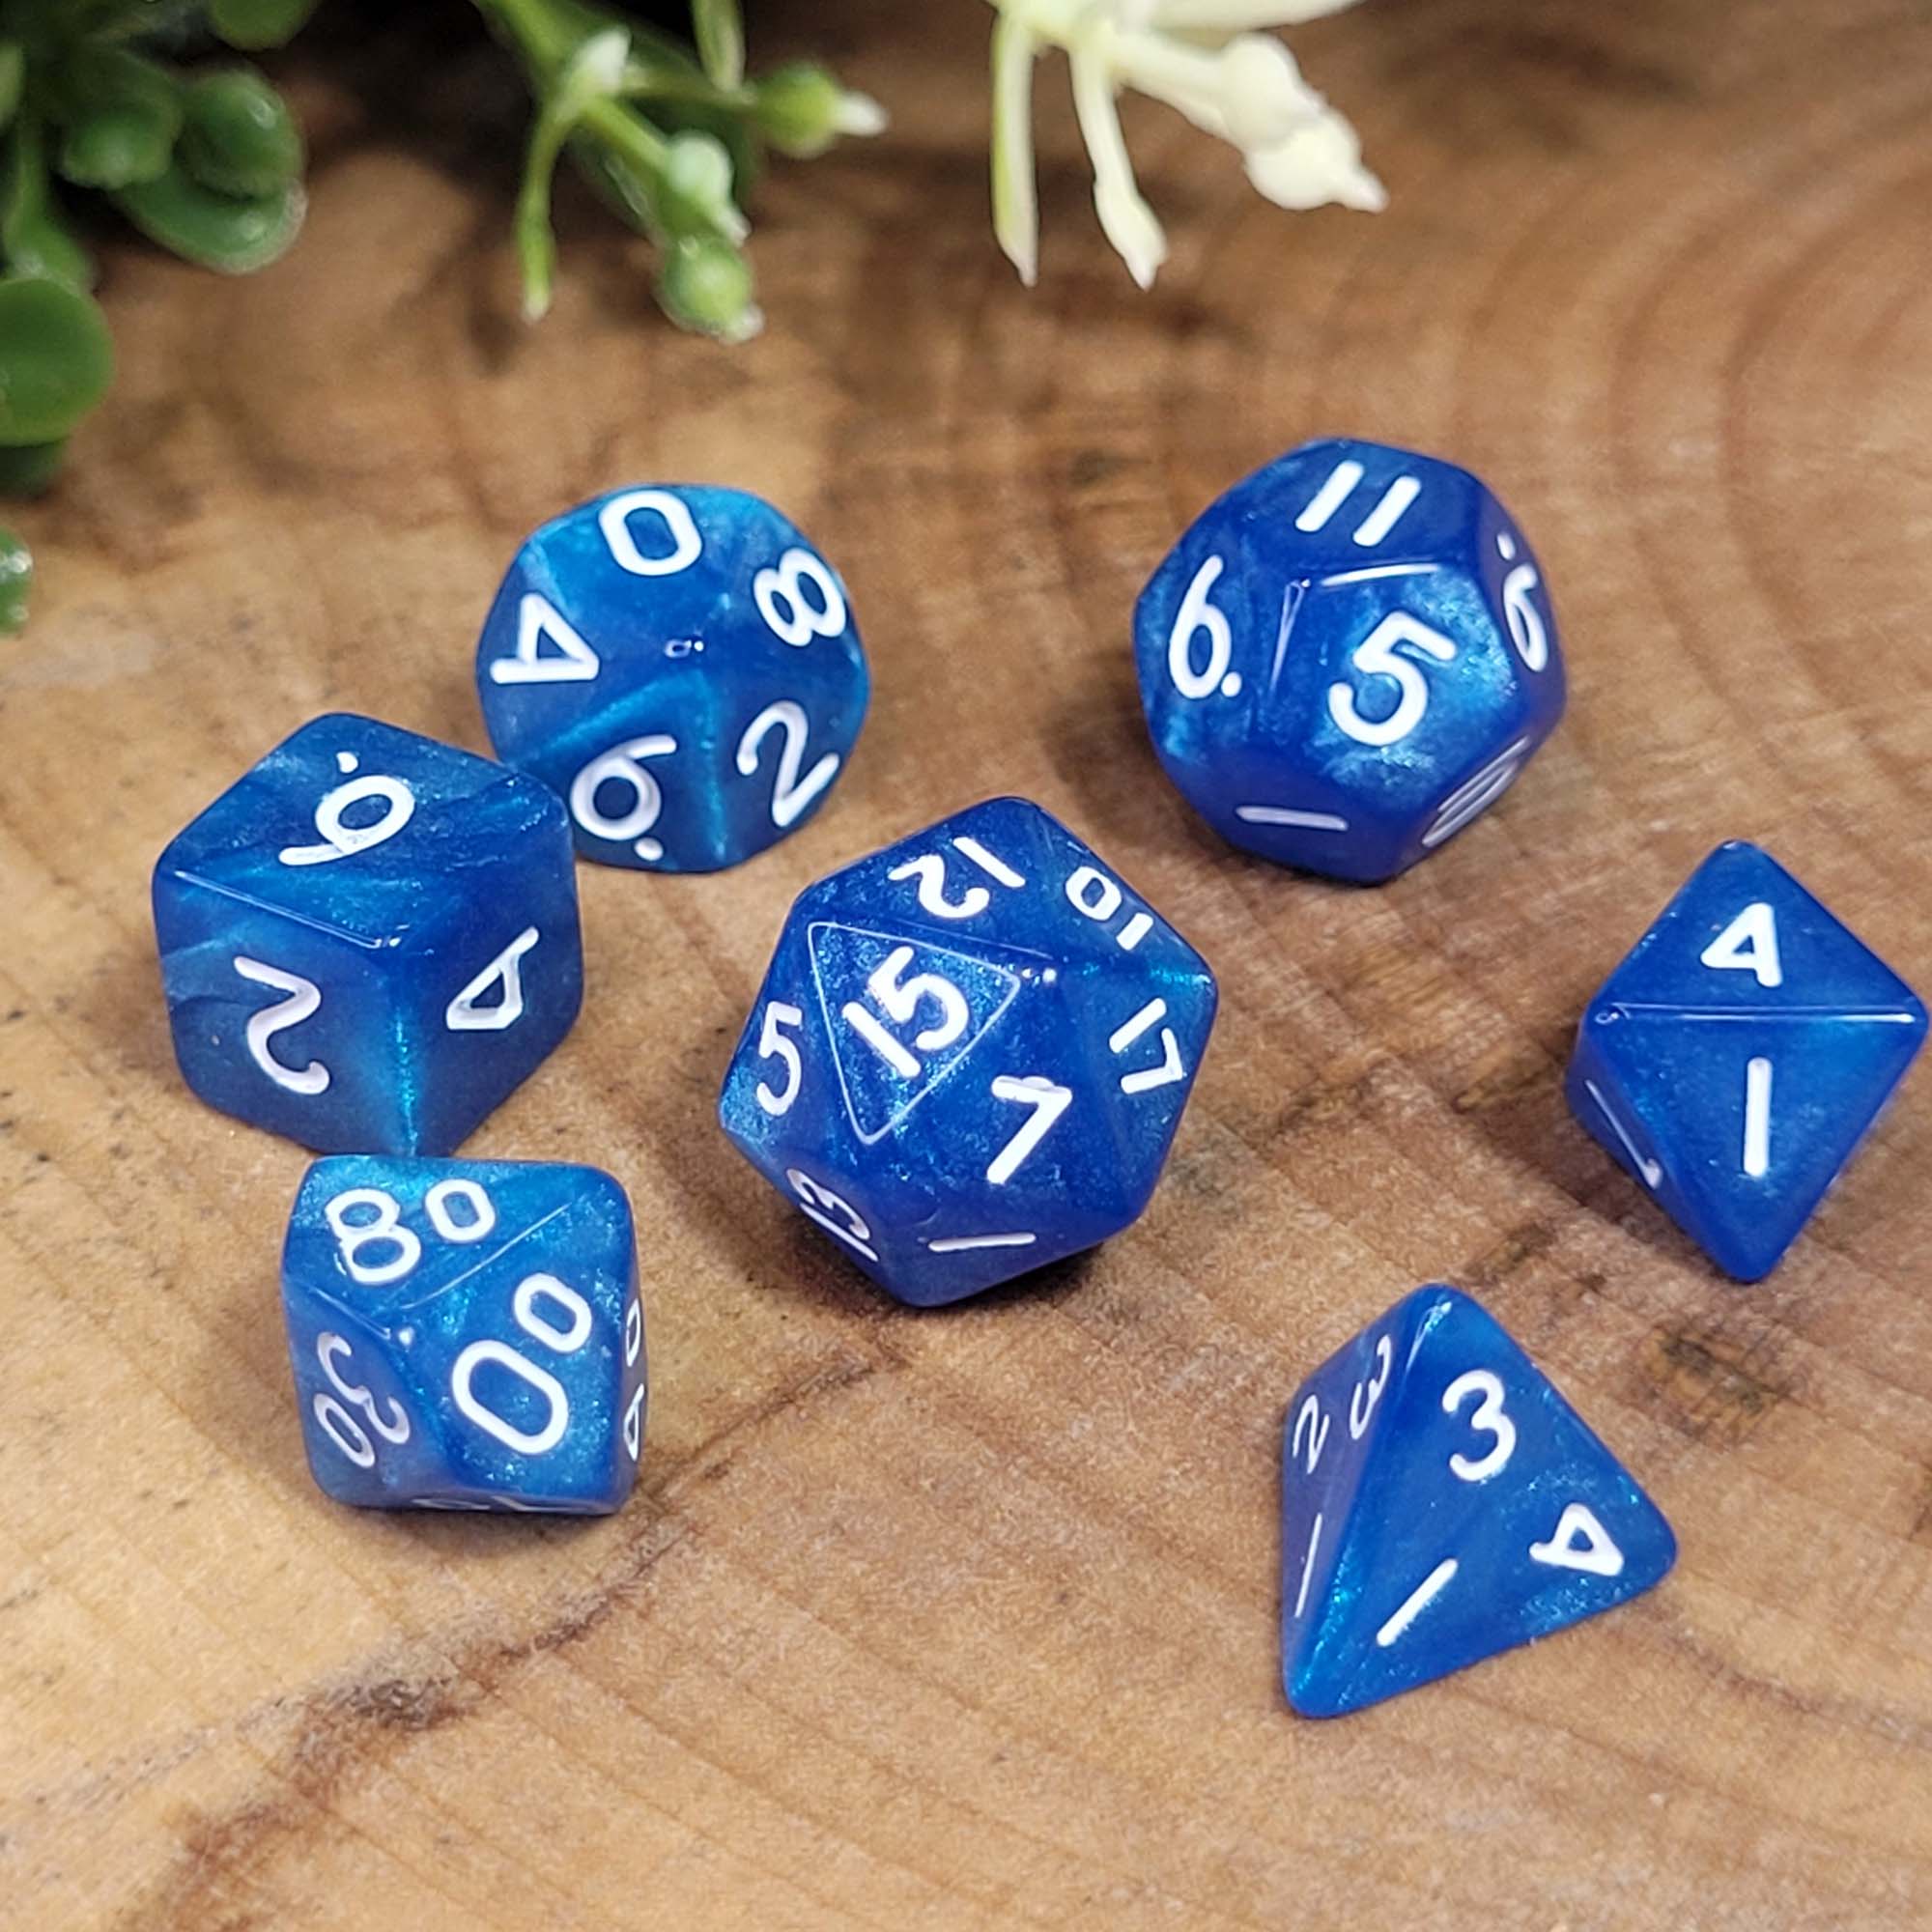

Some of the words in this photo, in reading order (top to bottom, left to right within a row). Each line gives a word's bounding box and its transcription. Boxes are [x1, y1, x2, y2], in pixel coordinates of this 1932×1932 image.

[598, 489, 702, 577] 0
[1294, 460, 1422, 548] 11
[490, 593, 600, 685] 4
[753, 548, 846, 646] 8
[1327, 611, 1458, 748] 5
[736, 700, 840, 828] 2
[888, 836, 1026, 921] 12
[1065, 865, 1155, 952] 10
[445, 925, 540, 1032] 4
[1700, 901, 1783, 988] 4
[233, 955, 331, 1095] 2
[754, 1000, 803, 1118] 5
[840, 945, 971, 1080] 15
[1108, 997, 1187, 1096] 17
[990, 1075, 1073, 1186] 7
[1743, 1057, 1773, 1179] 1
[325, 1178, 497, 1286] 80
[785, 1167, 879, 1263] 13
[312, 1331, 412, 1470] 30
[451, 1271, 593, 1456] 00
[1349, 1334, 1393, 1442] 3
[1292, 1393, 1332, 1476] 2
[1441, 1368, 1518, 1484] 3
[1293, 1512, 1323, 1619] 1
[1528, 1502, 1625, 1577] 4
[1375, 1557, 1460, 1648] 1
